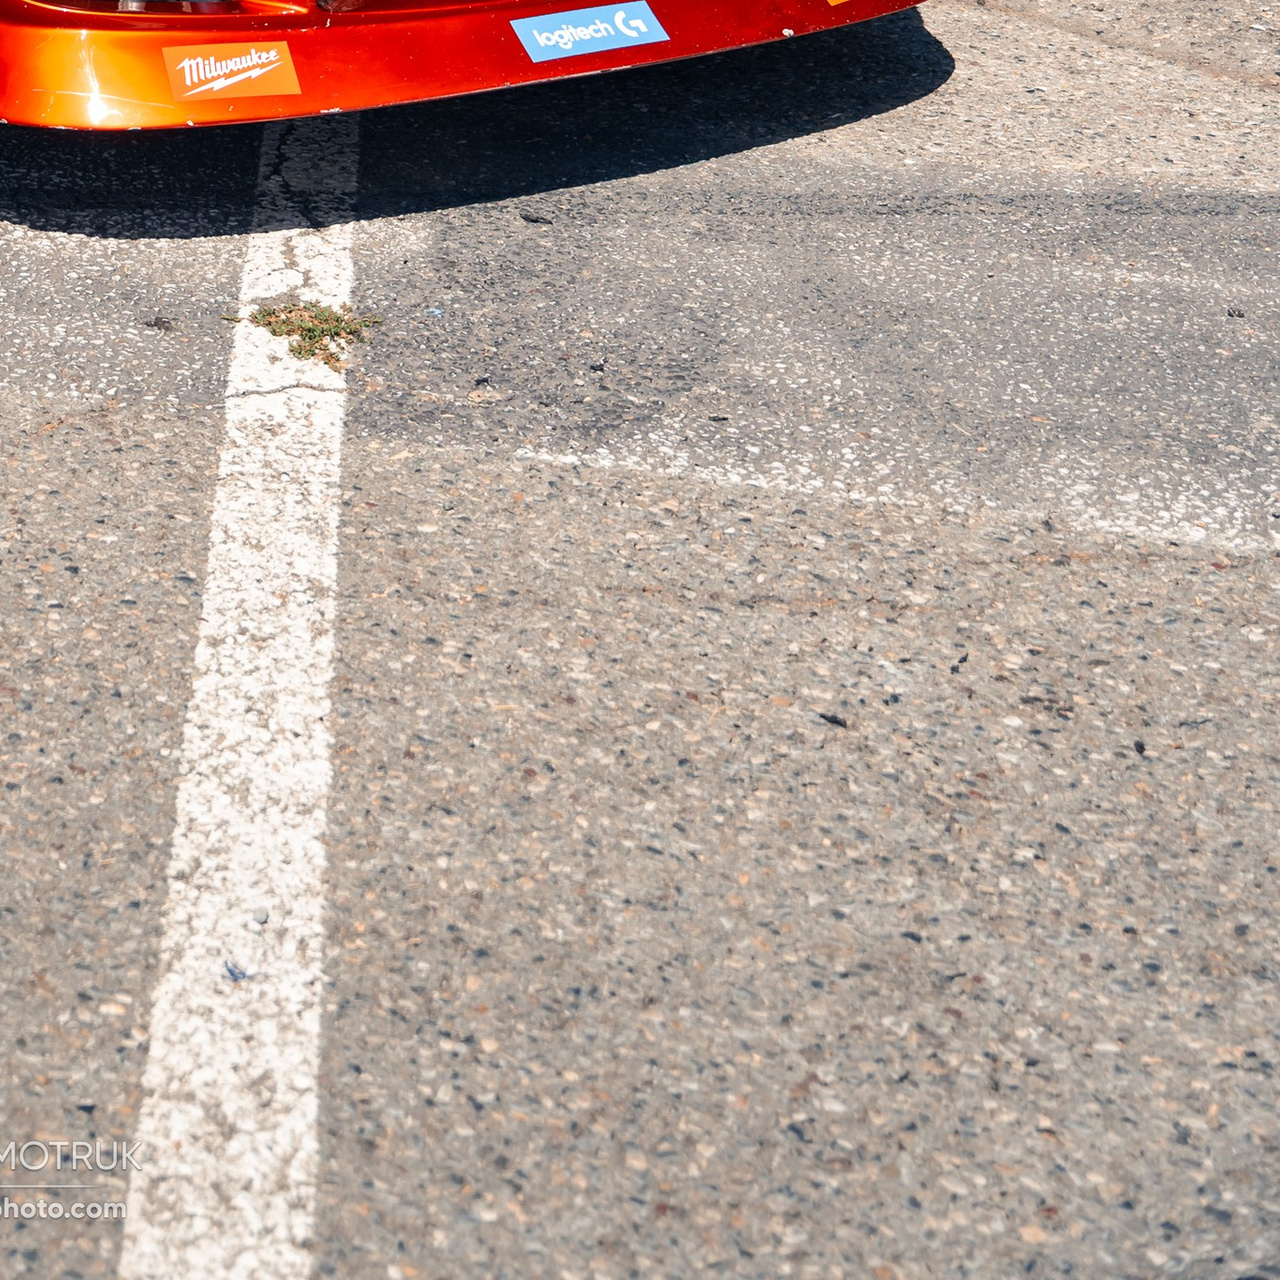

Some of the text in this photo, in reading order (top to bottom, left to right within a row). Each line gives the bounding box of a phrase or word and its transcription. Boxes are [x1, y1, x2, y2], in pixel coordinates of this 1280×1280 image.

[532, 10, 649, 50] logitech G
[175, 47, 280, 86] Milwaukee
